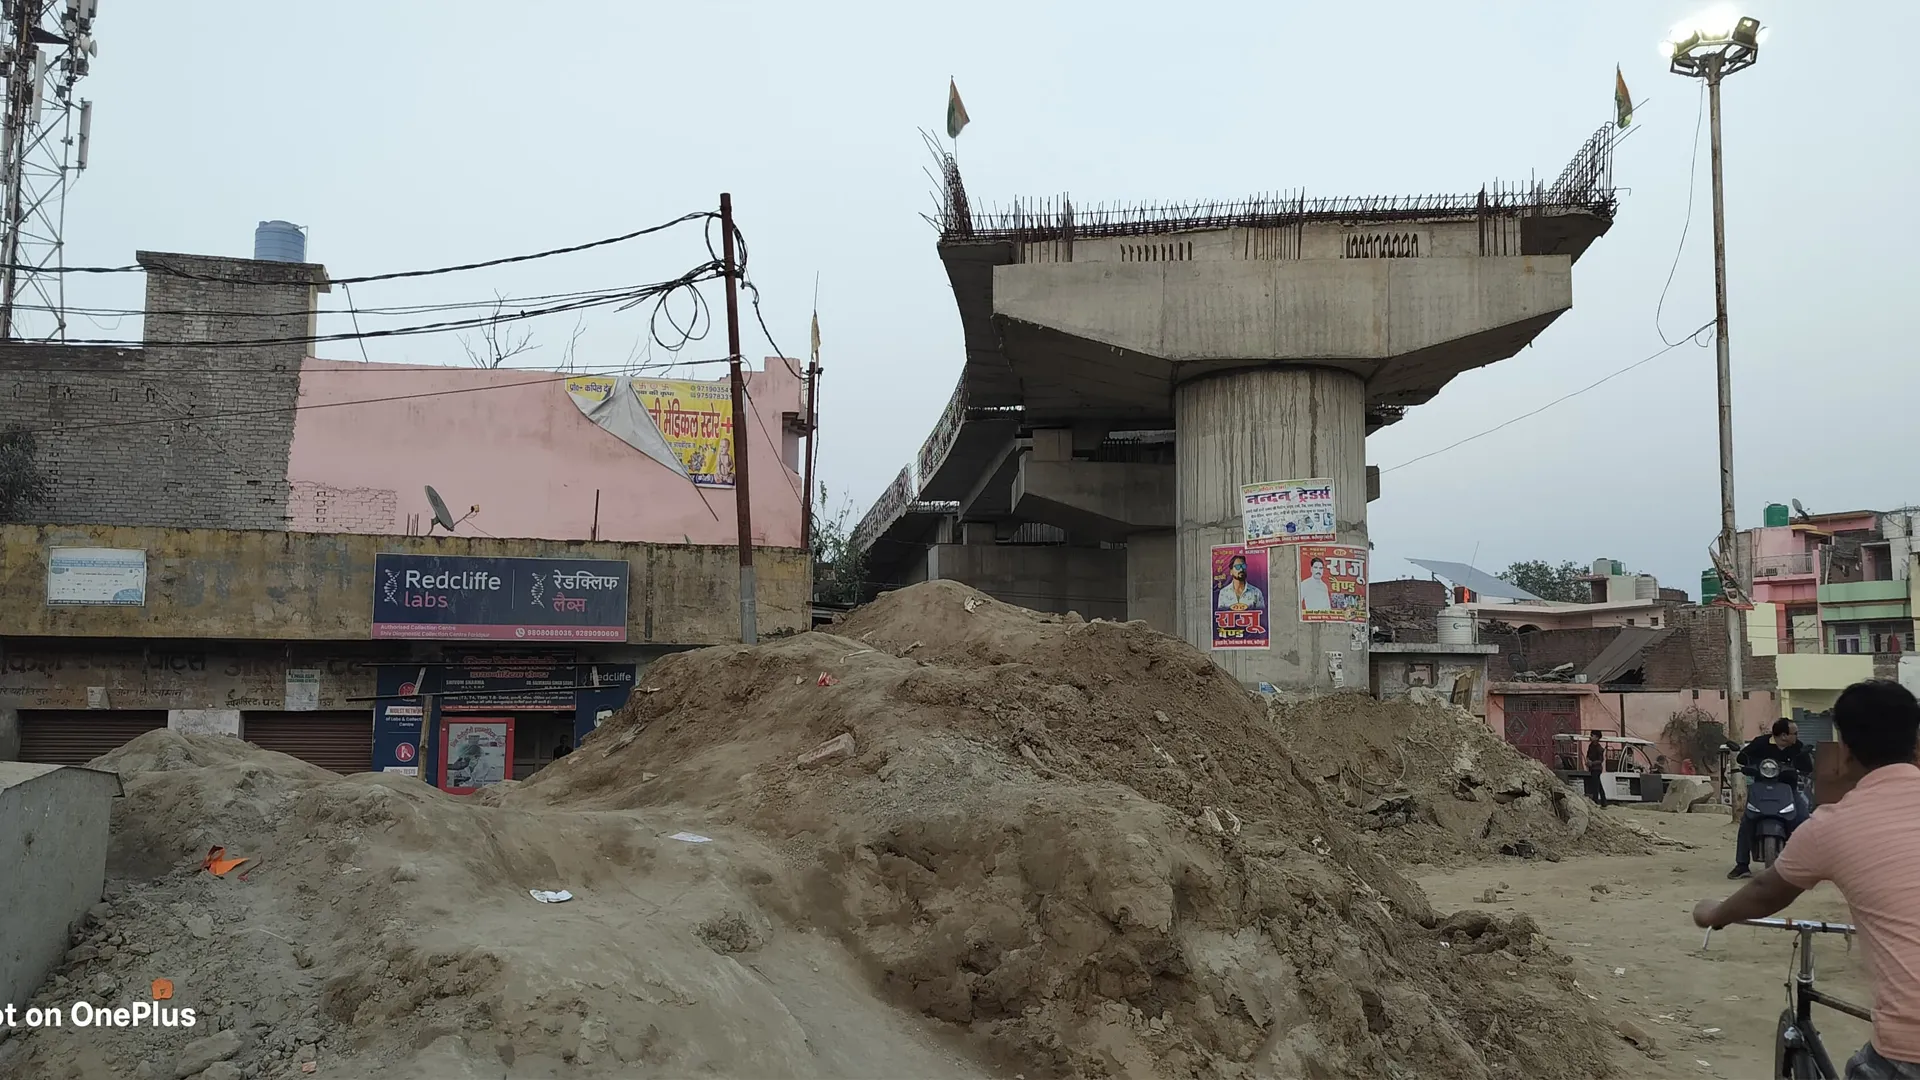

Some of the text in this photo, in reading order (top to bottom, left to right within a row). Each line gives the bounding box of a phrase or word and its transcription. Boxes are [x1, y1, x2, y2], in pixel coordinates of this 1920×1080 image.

[664, 398, 700, 439] मेडिकल
[701, 402, 721, 439] स्टोर
[1245, 485, 1331, 504] नन्दन ट्रेडर्स
[405, 569, 501, 591] Redcliffe
[553, 569, 620, 592] रेडक्लिफ
[404, 592, 449, 609] labs
[552, 592, 588, 613] लैब्स
[1215, 610, 1266, 634] राजू
